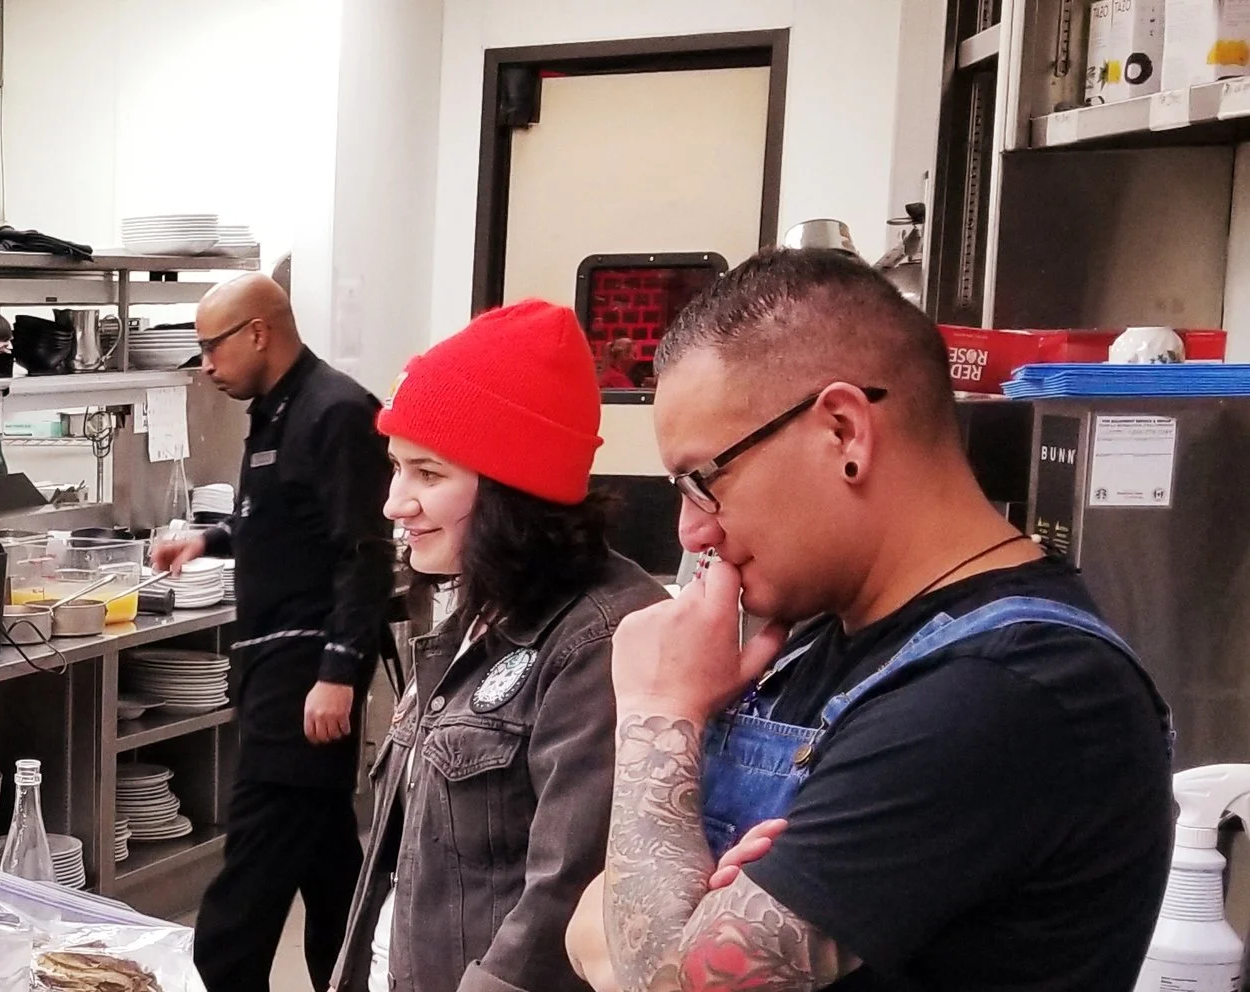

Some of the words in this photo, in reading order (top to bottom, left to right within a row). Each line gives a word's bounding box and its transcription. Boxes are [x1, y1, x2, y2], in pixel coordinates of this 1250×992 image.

[948, 347, 988, 366] ROSE
[950, 364, 982, 381] RED
[1041, 445, 1076, 465] BUNN
